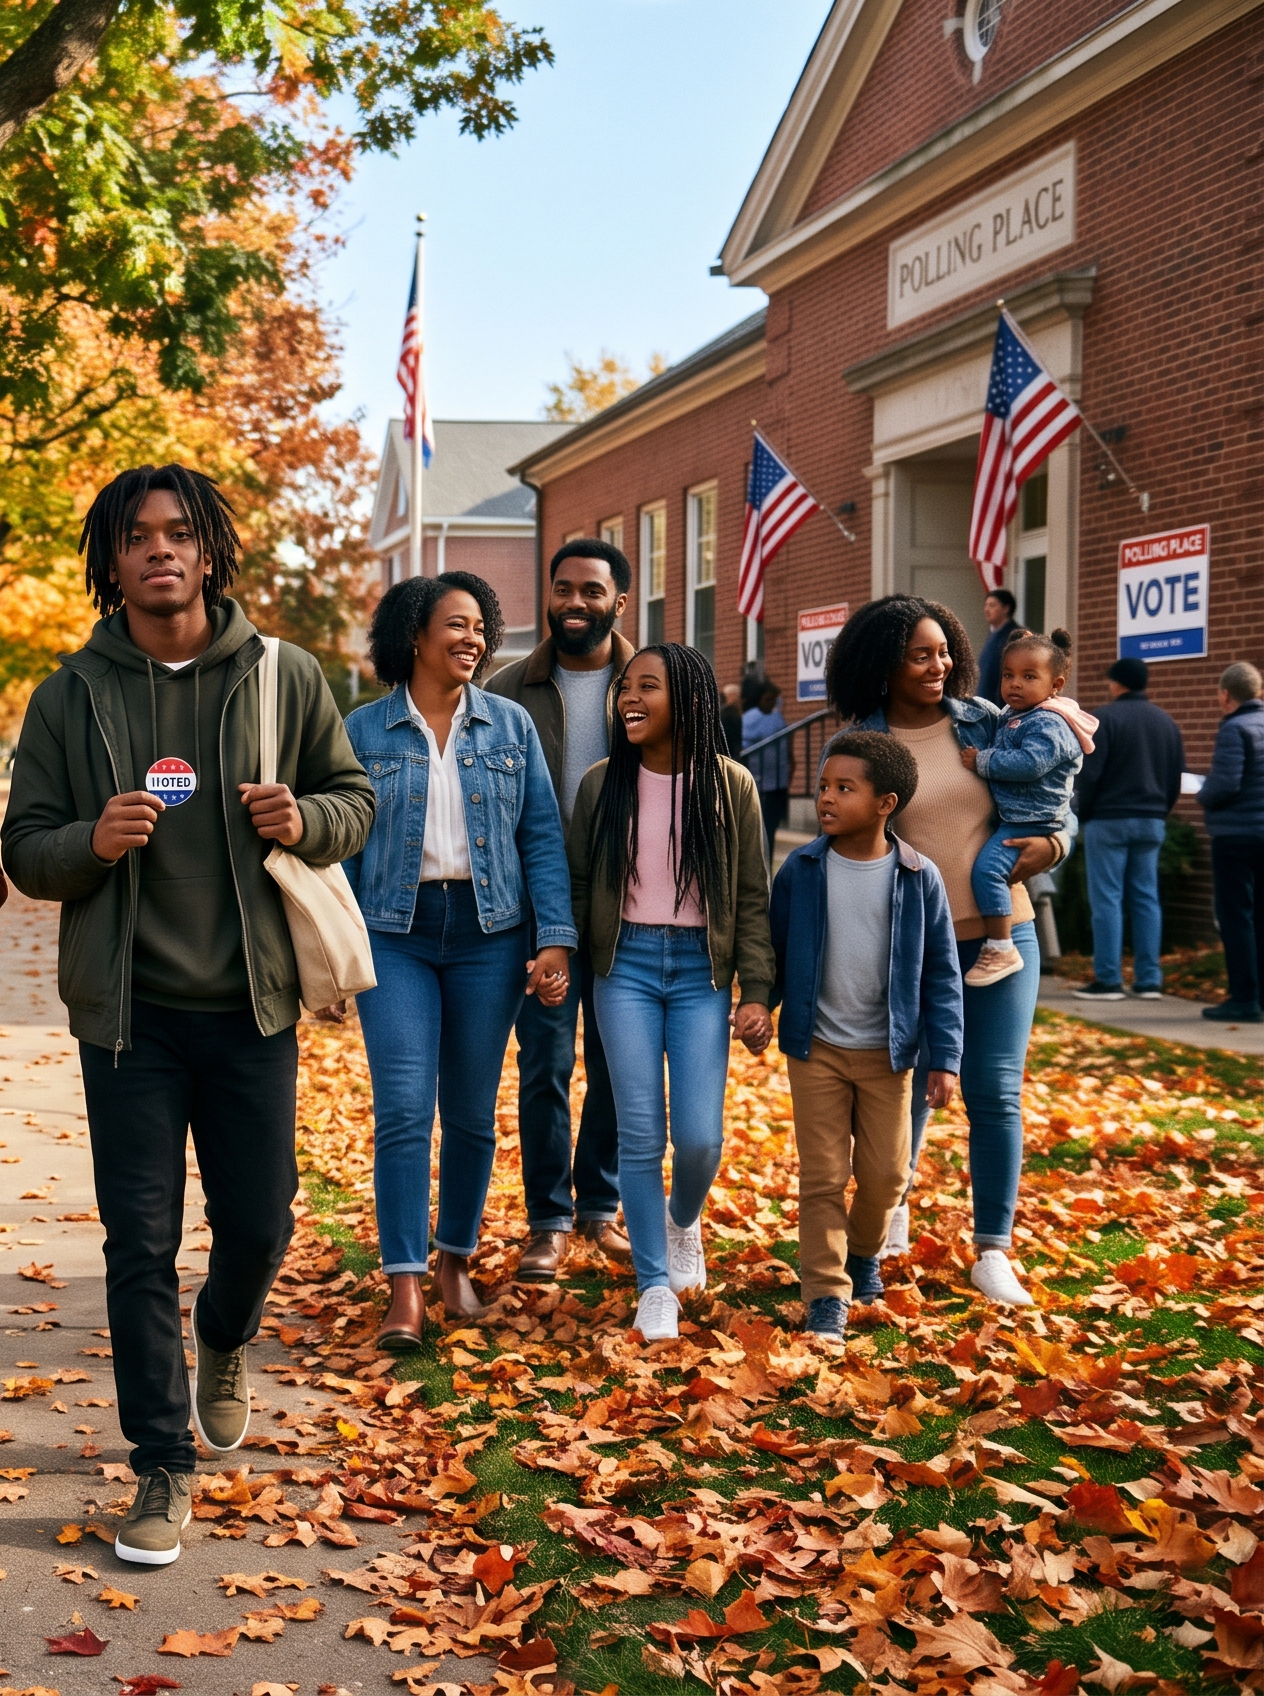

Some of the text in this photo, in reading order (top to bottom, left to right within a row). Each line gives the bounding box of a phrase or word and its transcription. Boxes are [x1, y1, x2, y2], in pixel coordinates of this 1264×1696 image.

[899, 178, 1065, 298] POLLING PLACE
[1124, 534, 1203, 563] POLLING PLACE
[1125, 571, 1200, 620] VOTE
